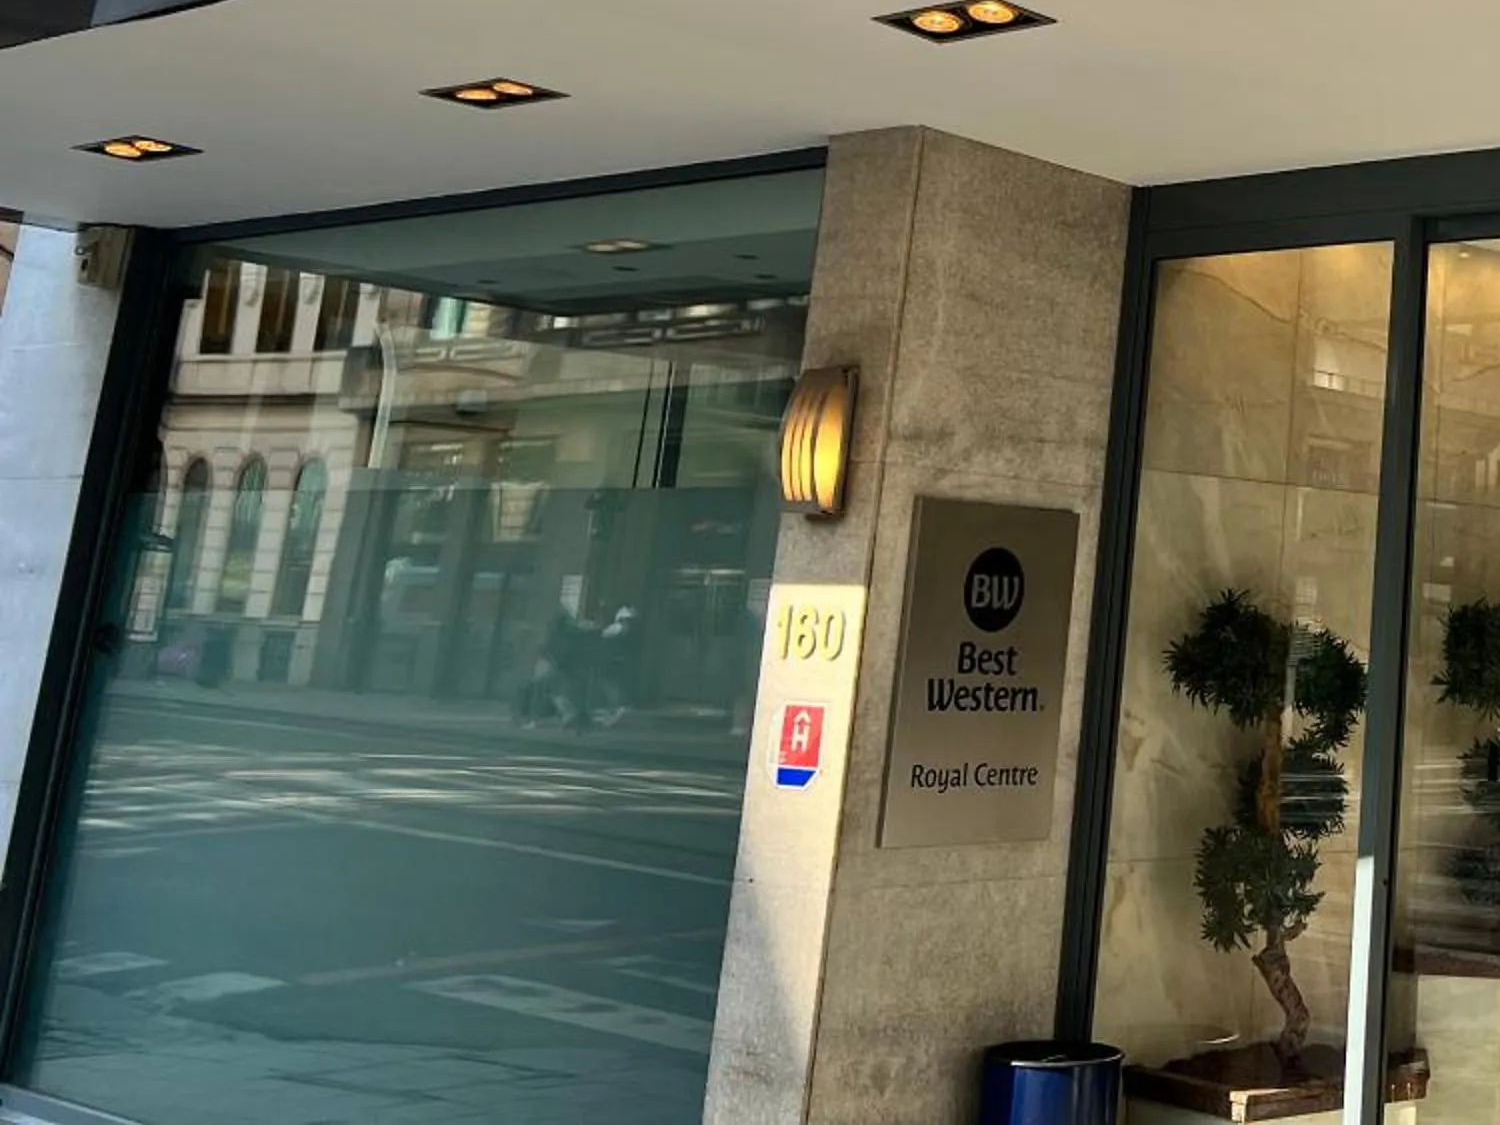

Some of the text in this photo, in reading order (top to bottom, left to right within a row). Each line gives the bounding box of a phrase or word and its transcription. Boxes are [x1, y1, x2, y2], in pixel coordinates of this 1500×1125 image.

[970, 573, 1020, 611] BW
[774, 603, 846, 662] 160
[957, 643, 1018, 675] Best
[910, 763, 1038, 794] Royal Centre
